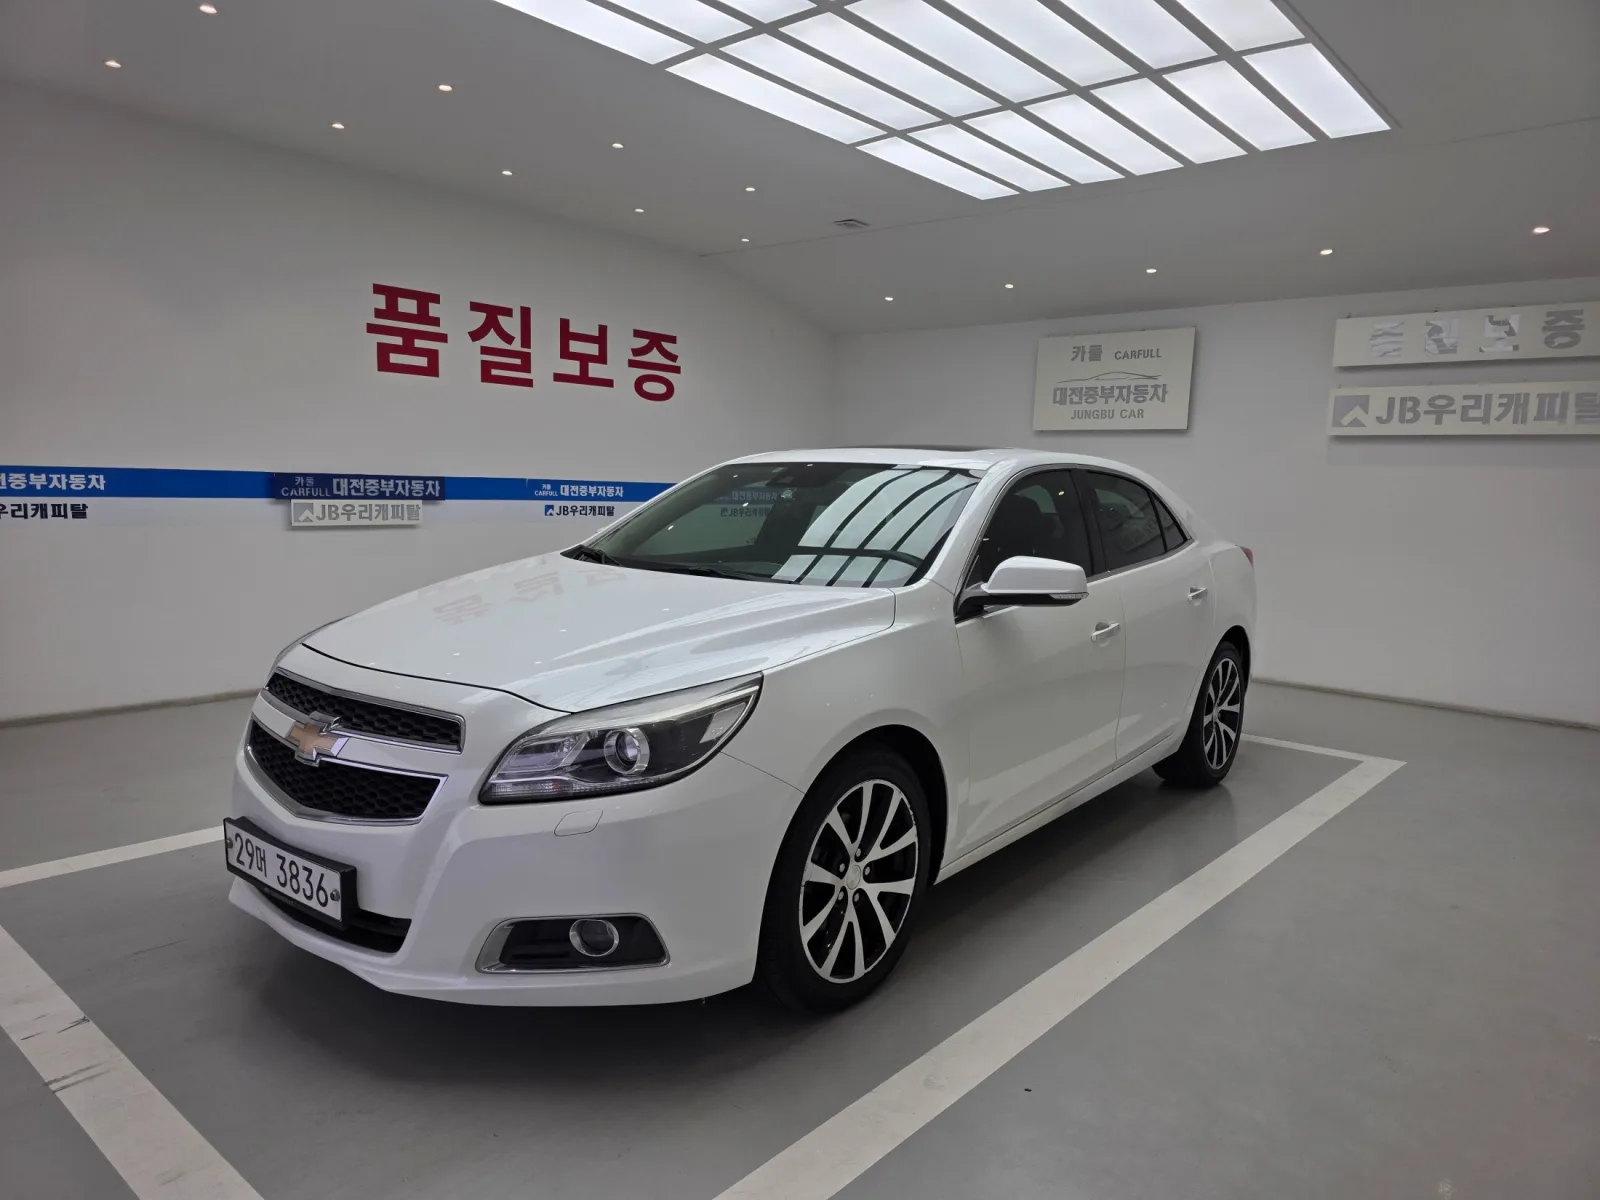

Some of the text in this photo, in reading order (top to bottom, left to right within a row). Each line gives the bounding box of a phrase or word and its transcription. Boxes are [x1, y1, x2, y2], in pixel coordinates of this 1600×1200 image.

[366, 283, 681, 402] 품질보증
[1114, 348, 1162, 361] CARFULL
[1052, 384, 1168, 406] 대전중부자동차
[1071, 408, 1144, 420] JUNGBU CAR
[281, 486, 331, 497] CARFULL
[332, 478, 440, 497] 대전중부자동차
[560, 484, 624, 498] 대전중부자동차
[315, 503, 421, 522] JB우리캐피탈
[555, 505, 615, 517] JB우리캐피탈
[234, 832, 329, 908] 29머 3836
